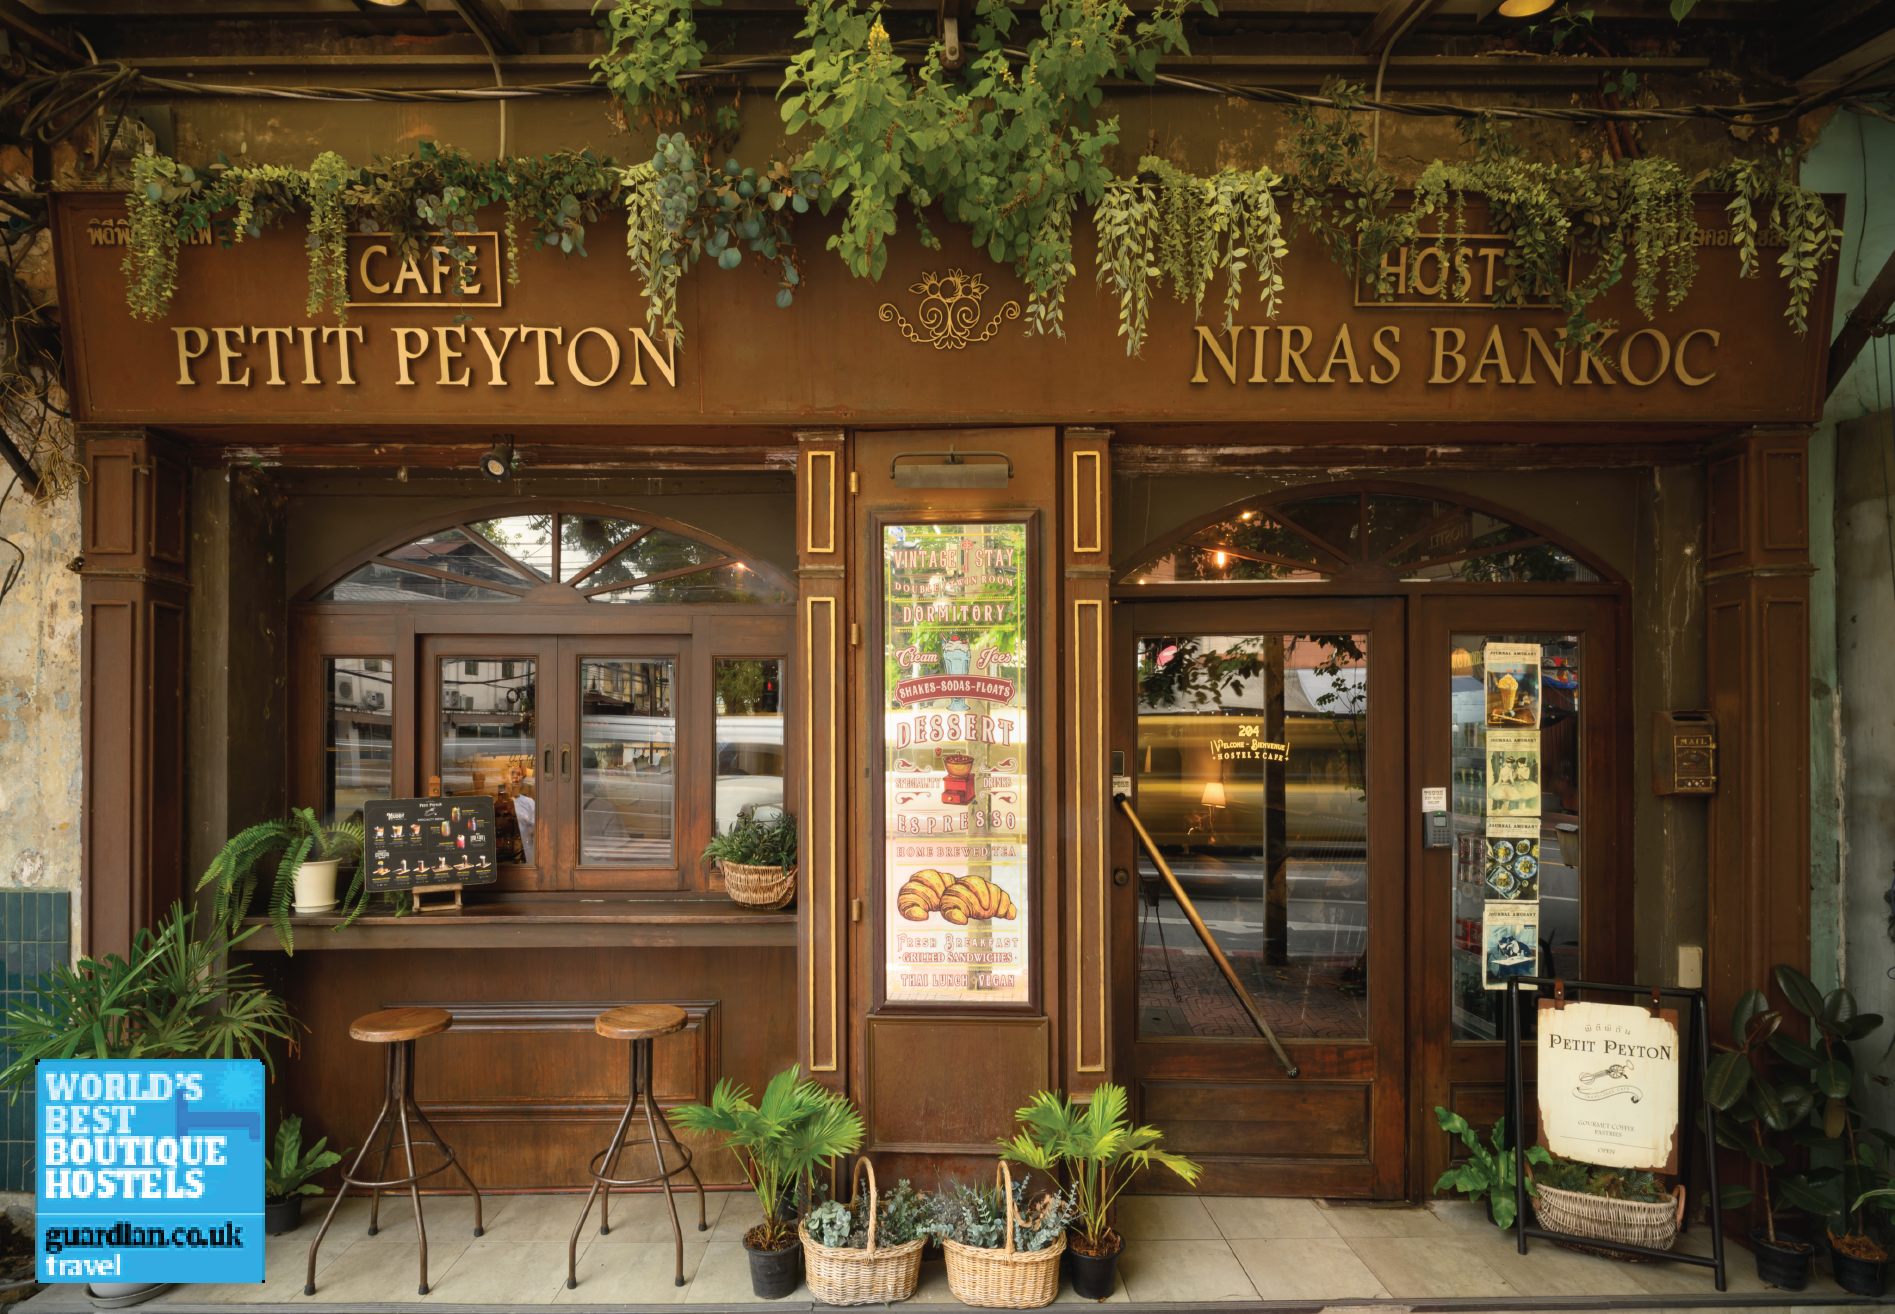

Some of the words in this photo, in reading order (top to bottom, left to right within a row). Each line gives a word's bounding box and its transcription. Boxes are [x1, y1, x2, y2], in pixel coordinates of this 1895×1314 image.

[171, 325, 365, 388] PETIT
[390, 324, 679, 389] PEYTON
[1190, 322, 1401, 385] NIRAS
[1427, 325, 1721, 388] BANKOC
[893, 549, 957, 570] VINTAGE
[975, 548, 1015, 567] STAY
[895, 581, 939, 594] DOUBLE
[981, 574, 1014, 587] ROOM
[903, 604, 1006, 624] DORMITORY
[895, 646, 939, 669] Cream
[976, 647, 1012, 669] Ices
[896, 713, 1015, 749] DESSERT
[1238, 725, 1260, 737] 204
[1217, 751, 1252, 760] HOSTEL
[1262, 752, 1284, 762] CAFE
[983, 776, 1012, 789] DRINKS
[897, 810, 1016, 834] ESPRESSO
[896, 846, 934, 857] HOME
[937, 846, 987, 857] BREWED
[991, 846, 1017, 857] TEA
[897, 934, 937, 951] FRESH
[943, 933, 1019, 951] BREAKFAST
[902, 952, 945, 963] GRILLED
[946, 951, 1013, 963] SANDWICHES
[900, 974, 928, 987] THAI
[933, 974, 968, 987] LUNCH
[978, 973, 1016, 987] VEGAN
[1549, 1033, 1596, 1052] PETIT
[1604, 1039, 1672, 1061] PEYTON
[1577, 1119, 1610, 1130] GOURMET
